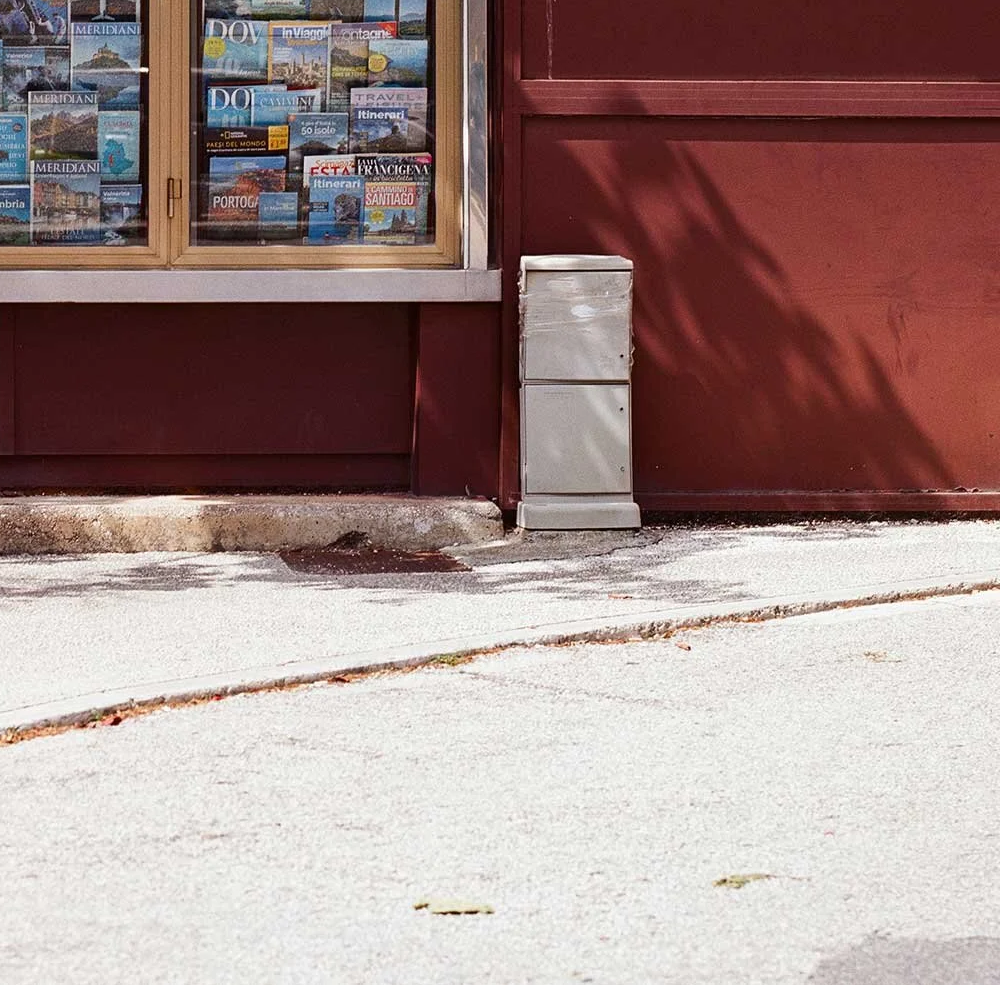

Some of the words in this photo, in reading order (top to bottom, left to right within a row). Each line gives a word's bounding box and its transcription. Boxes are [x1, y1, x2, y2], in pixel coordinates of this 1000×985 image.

[207, 21, 264, 44] DOV
[33, 93, 98, 104] MERIDIANI
[358, 110, 405, 120] Itinerari
[301, 126, 313, 136] 50
[314, 125, 336, 136] isole
[36, 162, 100, 173] MERIDIANI
[358, 164, 429, 176] FRANCIGENA
[314, 178, 361, 188] Itinerari
[366, 193, 414, 206] SANTIAGO
